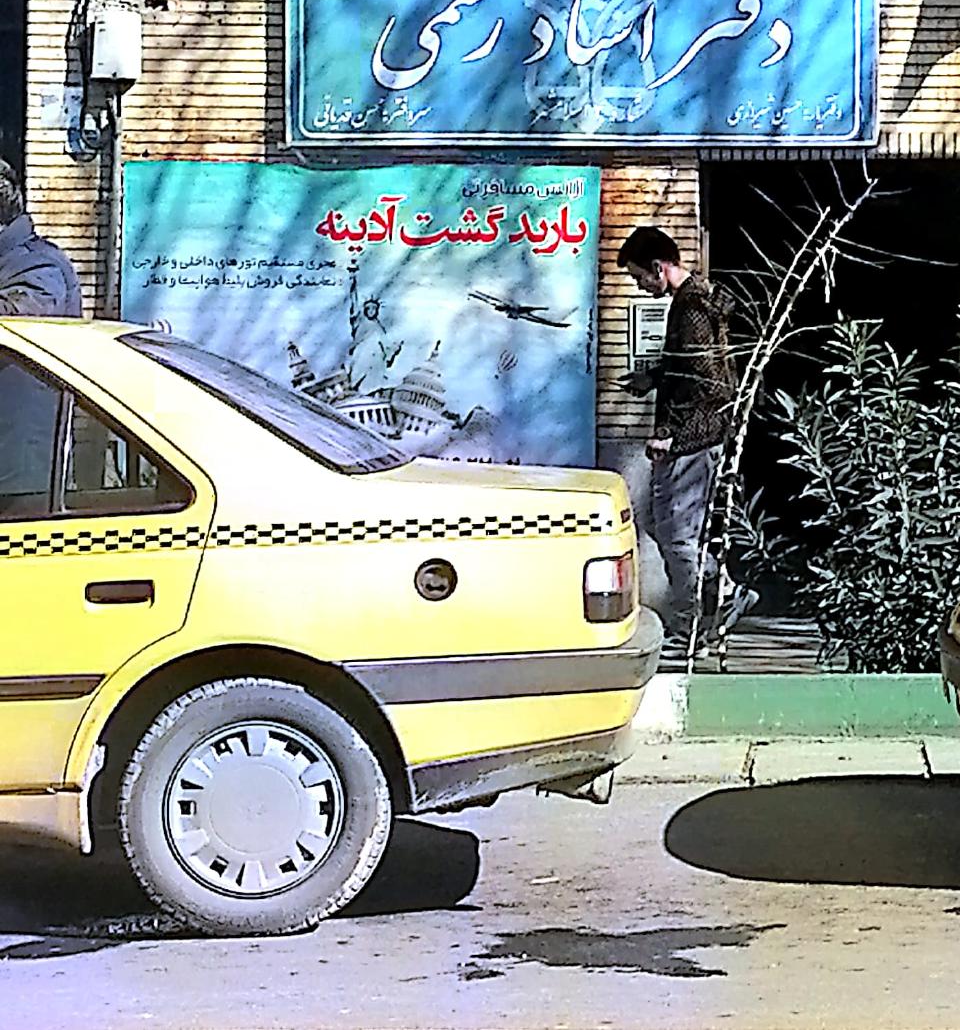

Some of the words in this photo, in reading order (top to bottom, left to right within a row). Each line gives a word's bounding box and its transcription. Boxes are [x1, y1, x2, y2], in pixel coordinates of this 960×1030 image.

[314, 196, 404, 253] آدینه
[401, 206, 505, 247] گشت
[132, 255, 170, 270] خارجی
[171, 258, 177, 270] و
[179, 255, 214, 270] داخلی
[257, 255, 304, 268] مستقیم
[246, 273, 283, 289] فروش
[285, 273, 336, 289] نمایندگی
